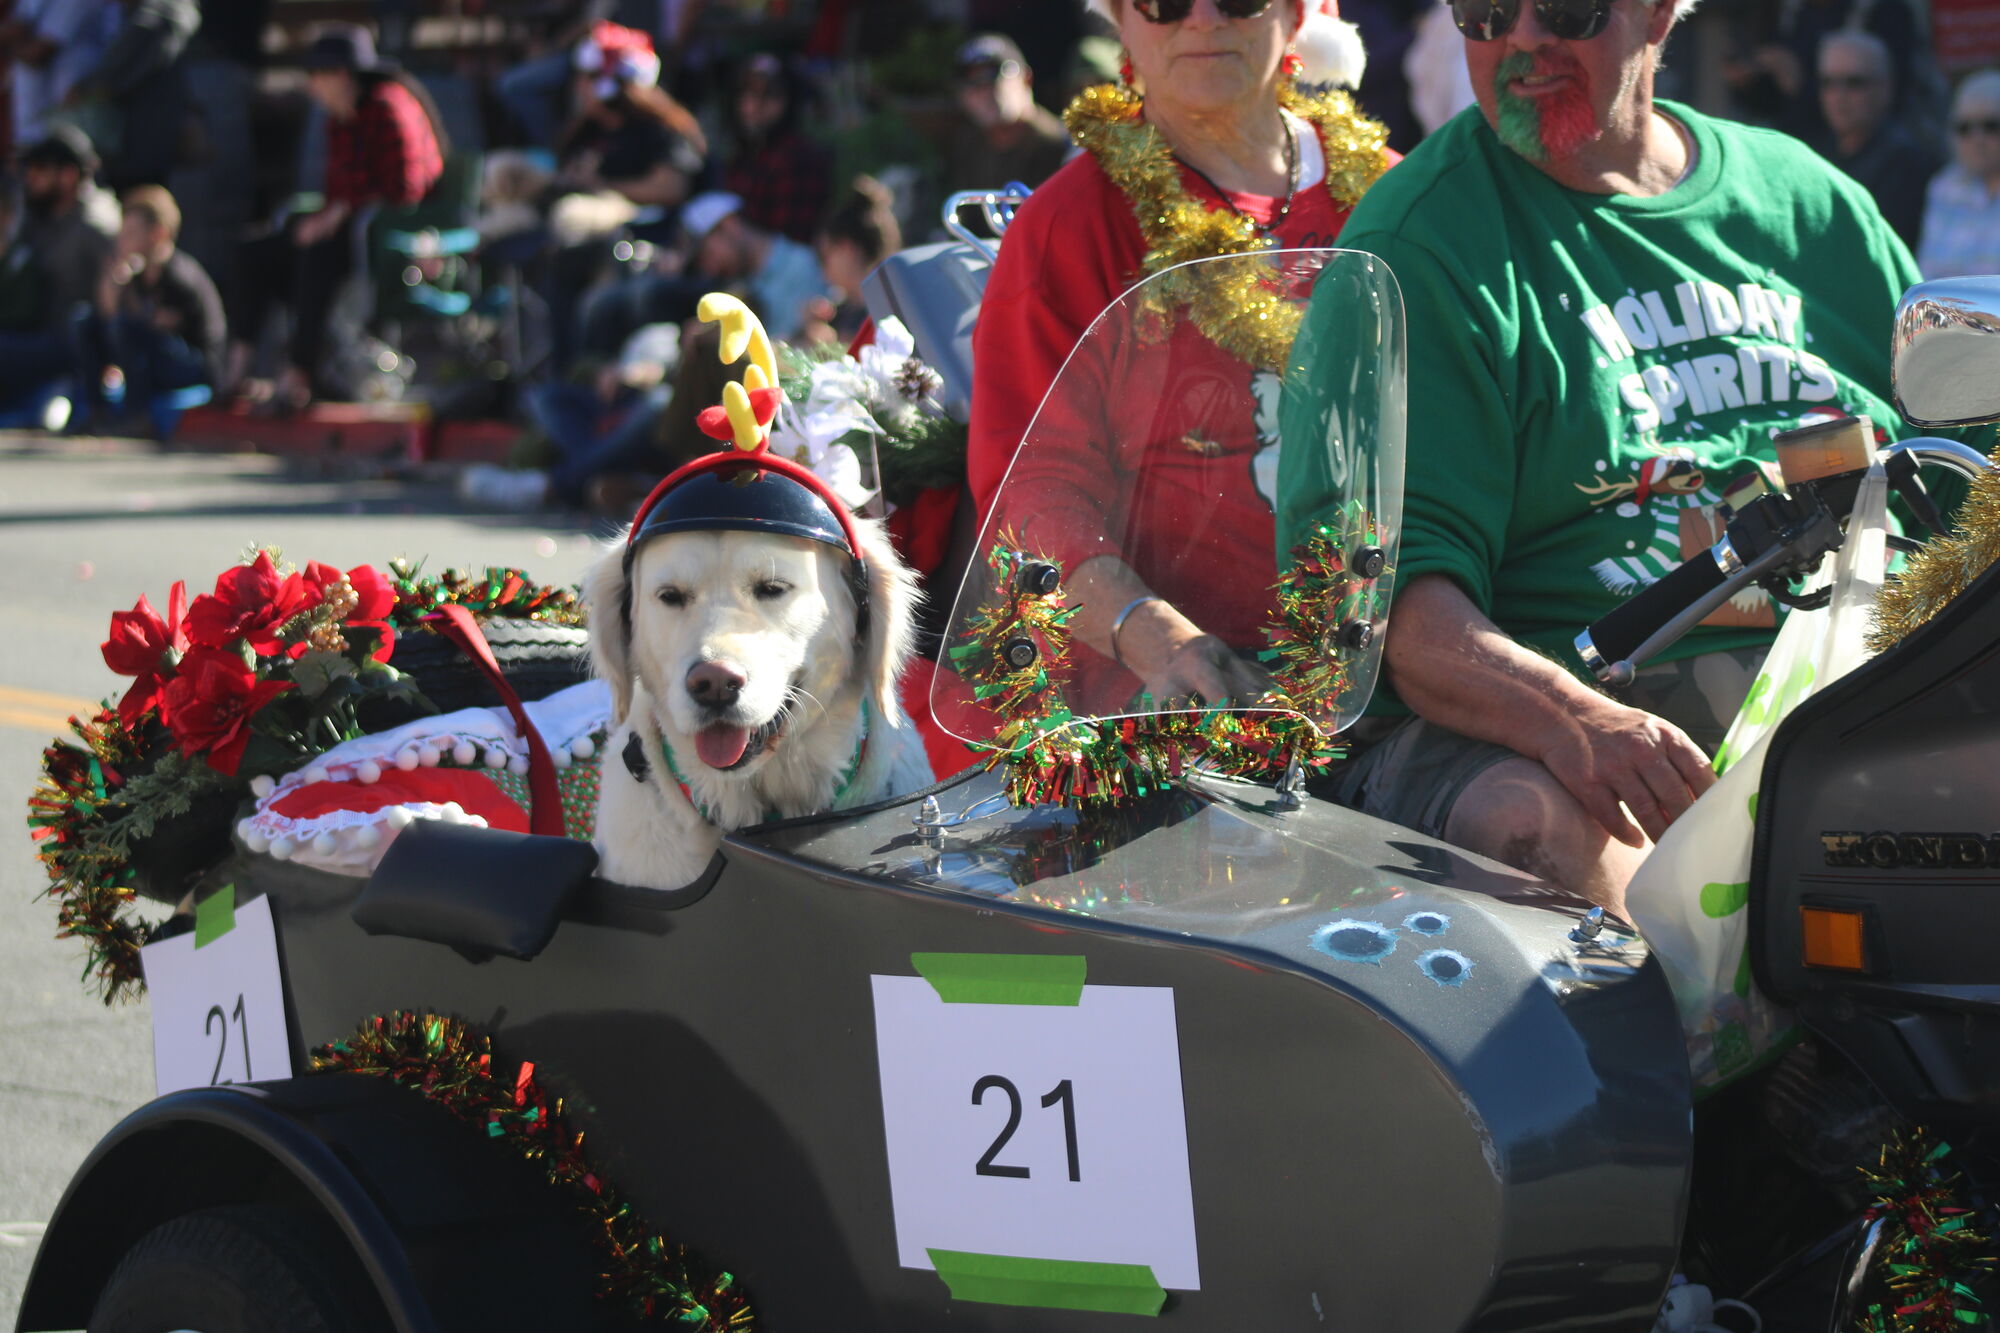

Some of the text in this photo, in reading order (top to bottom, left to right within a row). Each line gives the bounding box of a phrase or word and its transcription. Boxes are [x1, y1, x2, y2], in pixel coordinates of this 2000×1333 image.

[1579, 280, 1802, 362] HOLIDAY
[1618, 345, 1838, 433] SPIRITS
[1821, 830, 2000, 869] HOND
[206, 992, 252, 1087] 21
[971, 1074, 1081, 1182] 21
